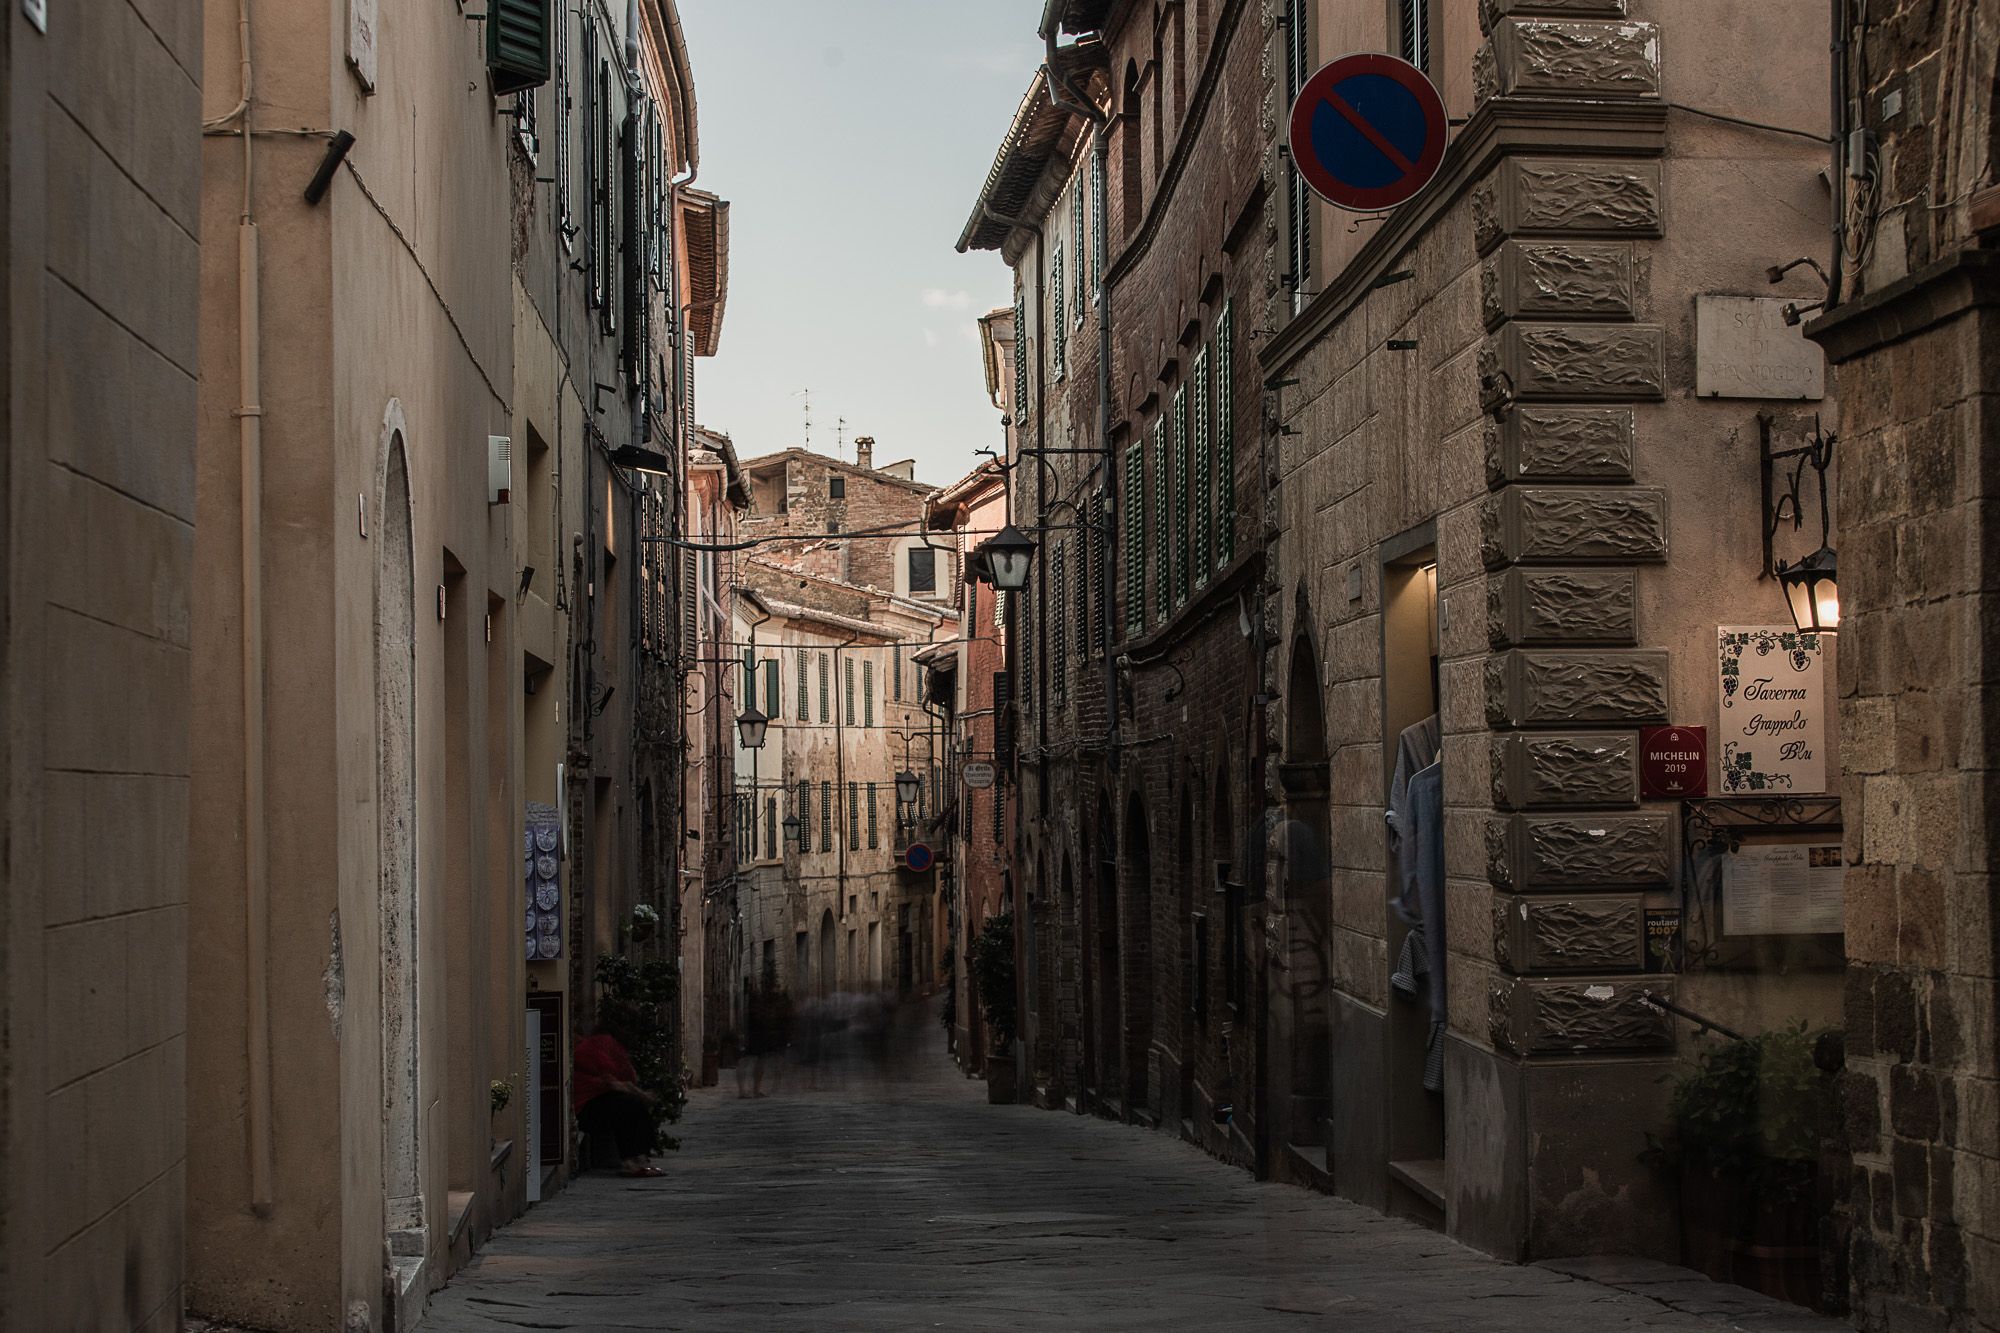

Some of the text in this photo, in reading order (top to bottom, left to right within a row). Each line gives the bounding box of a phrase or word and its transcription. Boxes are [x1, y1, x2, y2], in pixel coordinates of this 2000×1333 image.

[1751, 339, 1769, 355] DI
[1744, 676, 1807, 701] Taverna
[1743, 710, 1808, 737] Grappolo
[1650, 751, 1700, 761] MICHELIN
[1780, 740, 1813, 761] Blu
[1664, 763, 1687, 773] 2019
[1647, 917, 1678, 926] routard
[1648, 926, 1678, 936] 2007
